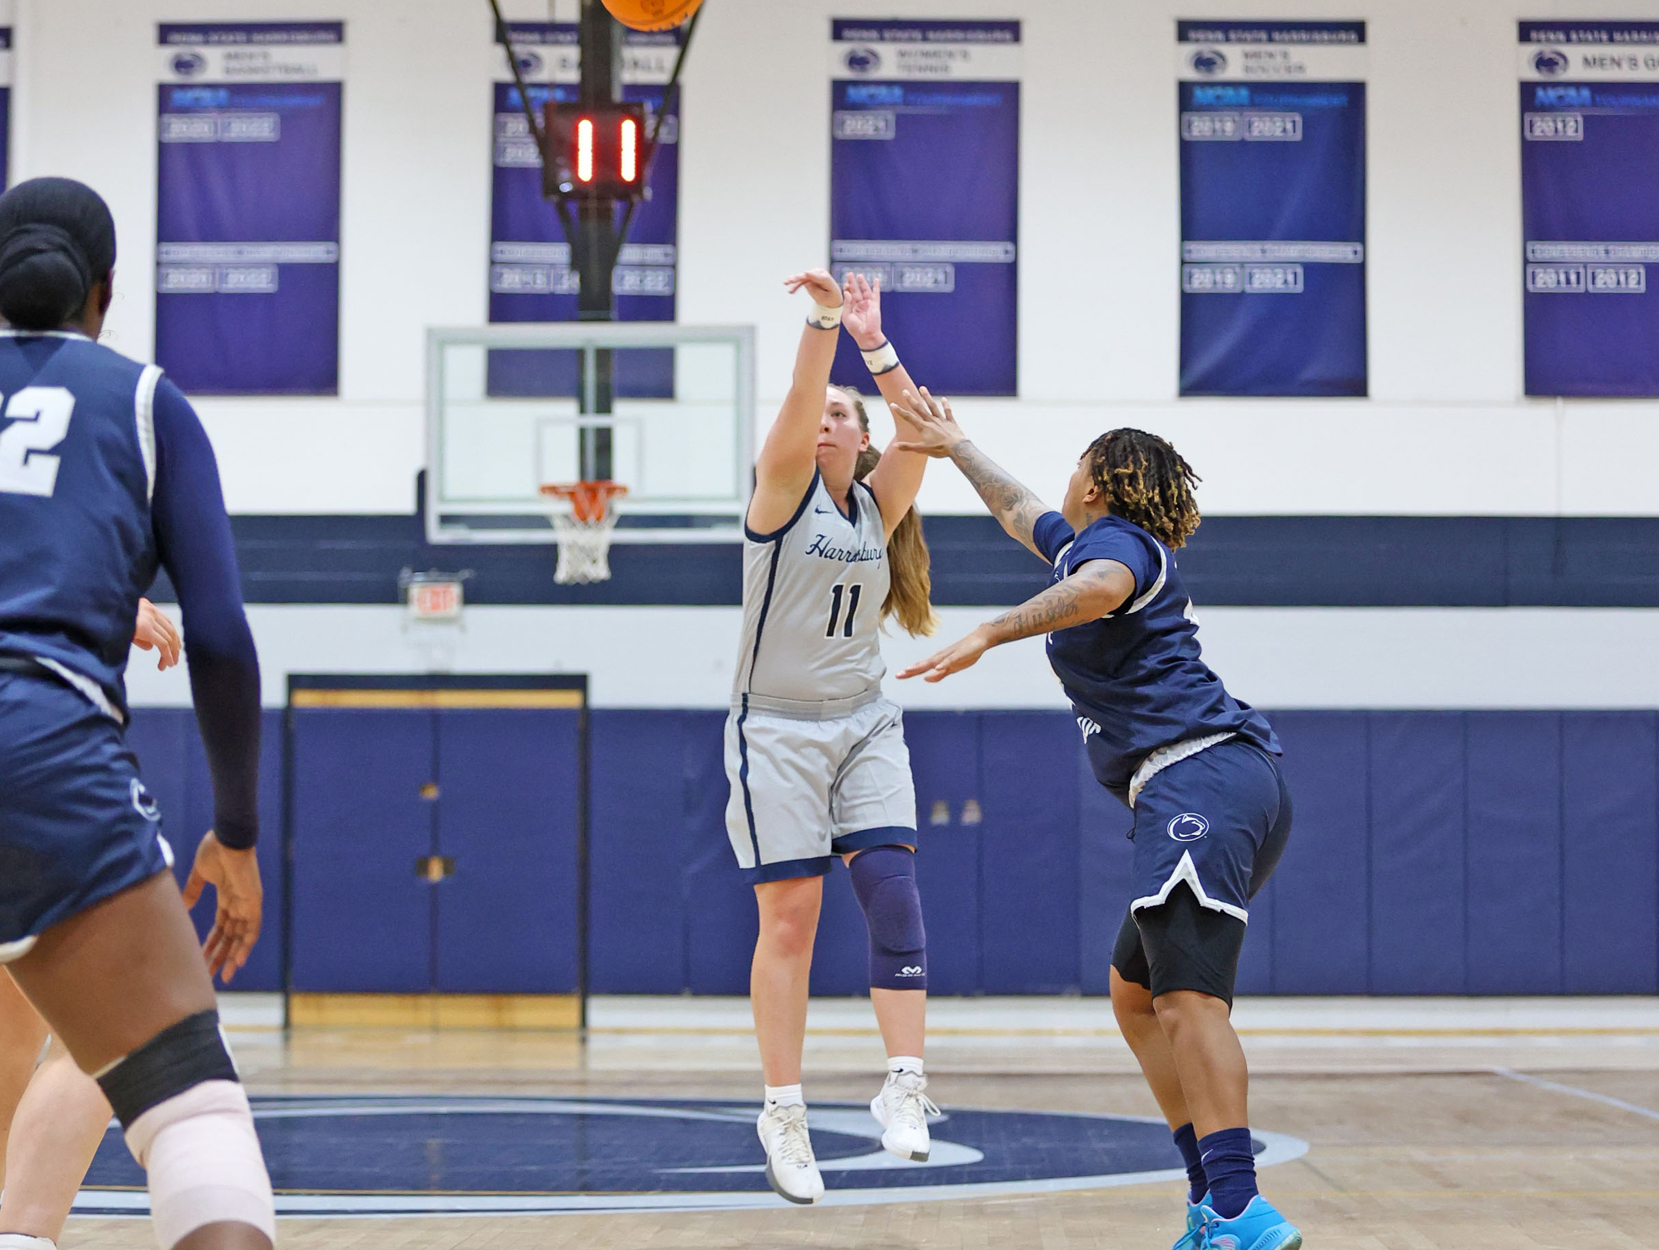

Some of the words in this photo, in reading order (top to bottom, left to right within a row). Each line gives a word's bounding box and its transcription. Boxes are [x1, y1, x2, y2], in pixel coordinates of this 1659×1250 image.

[1569, 30, 1608, 42] STATE
[1582, 53, 1640, 71] MEN'S
[1531, 116, 1579, 137] 2012
[577, 119, 636, 182] 11
[1534, 268, 1579, 289] 2011
[1593, 268, 1640, 289] 2012
[0, 386, 76, 498] 2
[805, 533, 882, 570] Harrsburg
[824, 582, 864, 640] 11
